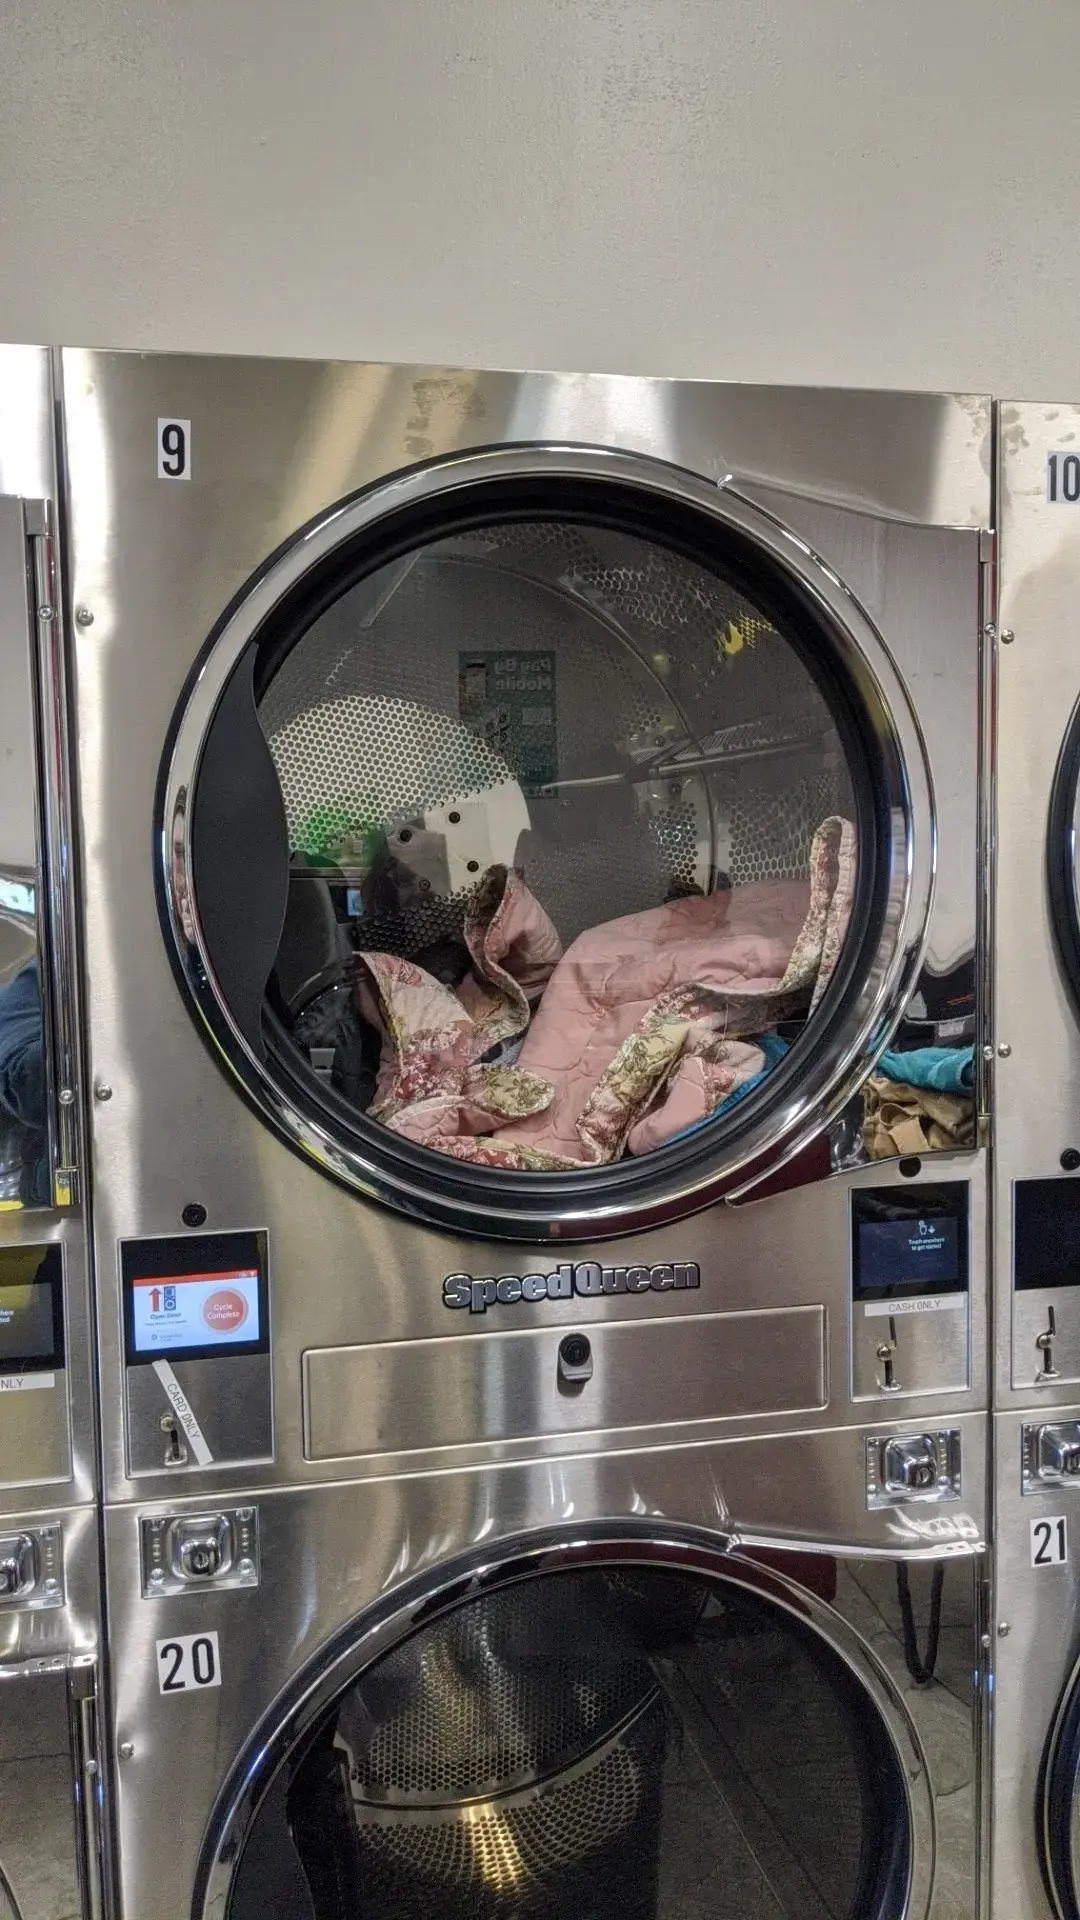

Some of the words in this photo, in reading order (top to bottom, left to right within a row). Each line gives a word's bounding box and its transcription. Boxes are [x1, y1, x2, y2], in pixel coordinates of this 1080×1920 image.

[162, 424, 185, 476] 9
[1048, 455, 1080, 501] 10
[207, 1311, 240, 1320] Complete
[213, 1303, 233, 1311] Cycle
[889, 1303, 915, 1313] CASH
[917, 1300, 941, 1310] ONLY
[0, 1378, 24, 1389] NLY
[167, 1383, 187, 1413] CARD
[181, 1413, 201, 1438] ONLY
[1033, 1519, 1066, 1565] 21
[160, 1637, 215, 1691] 20
